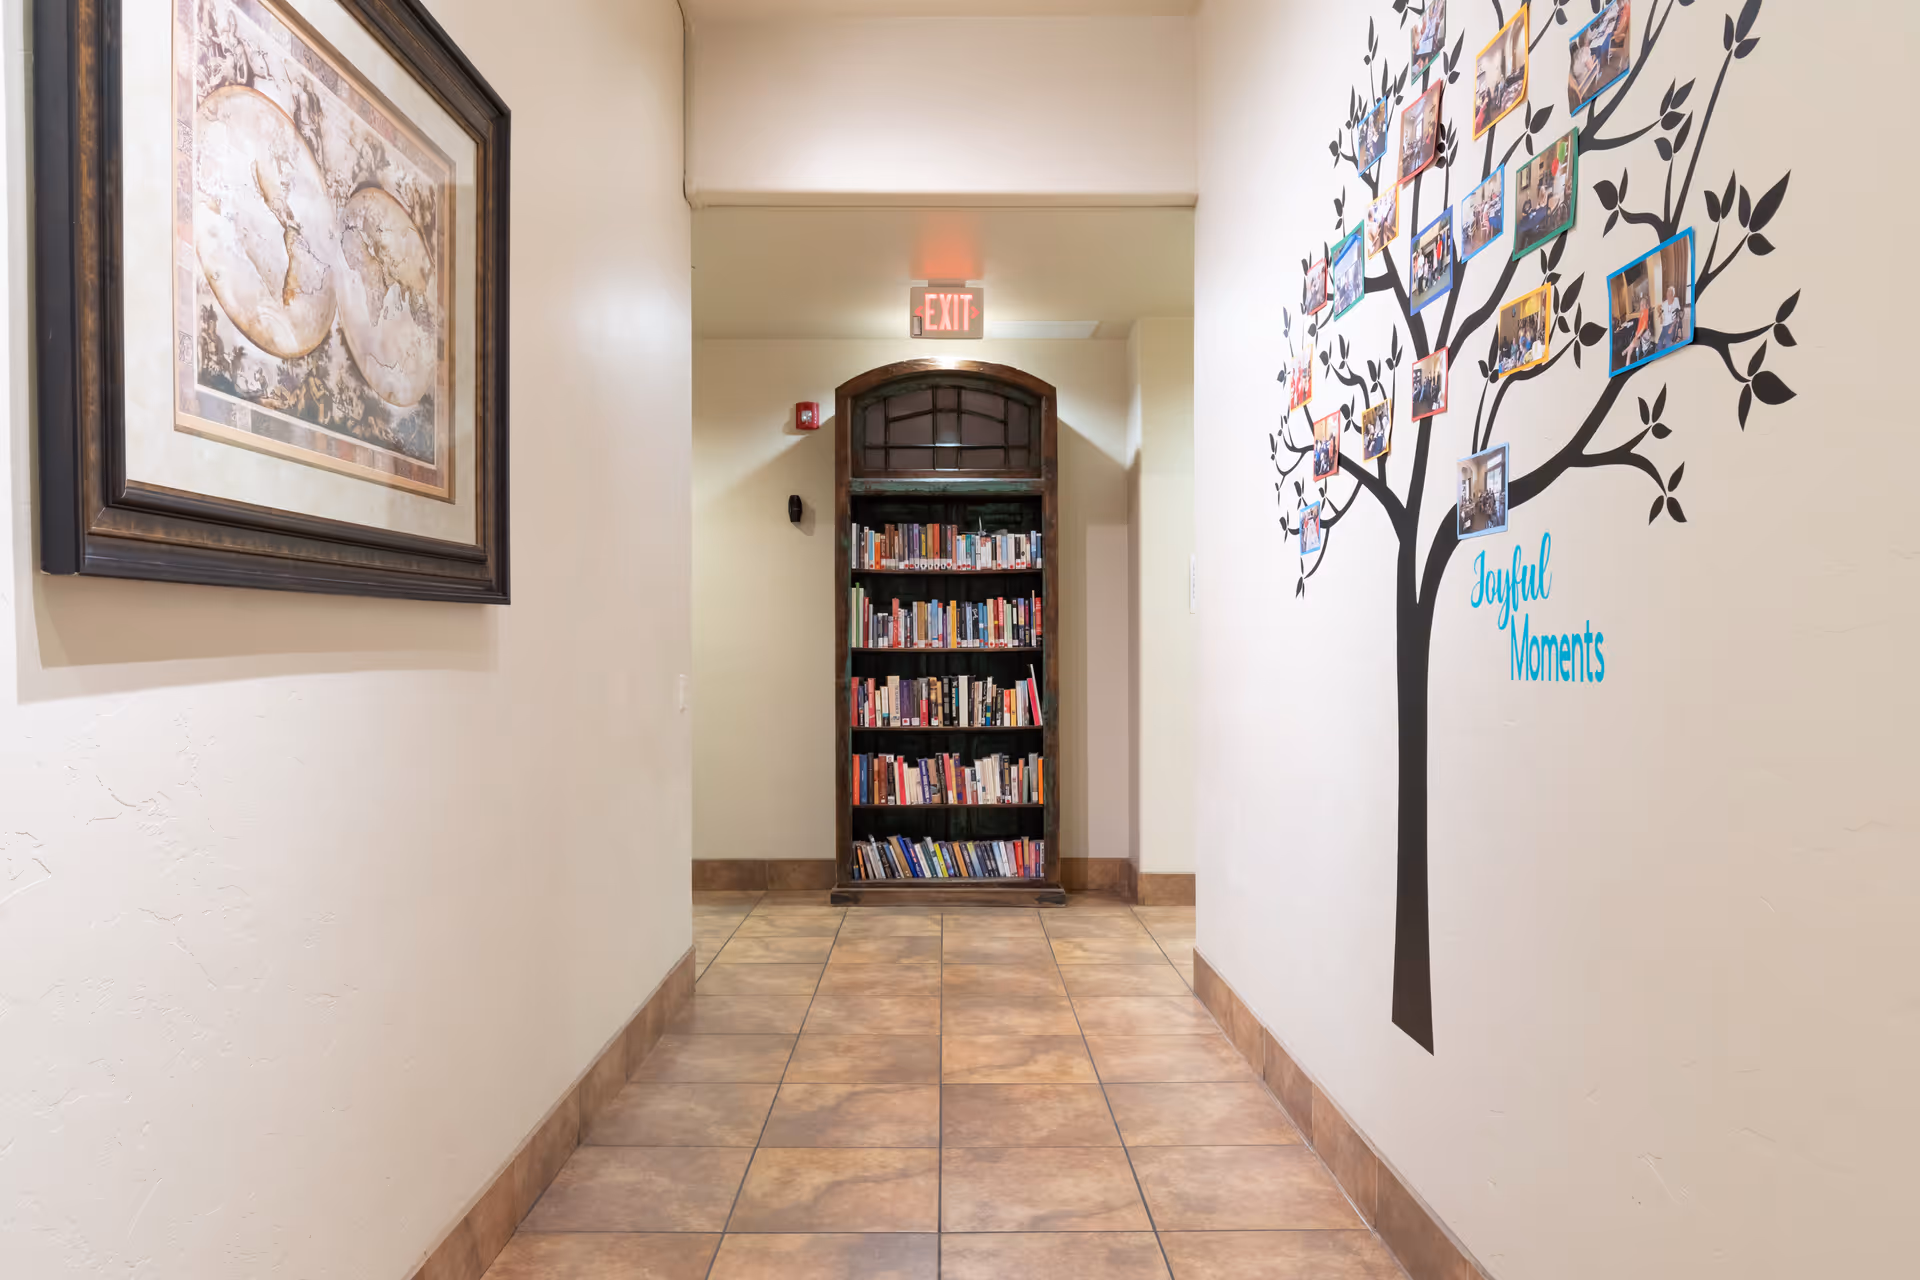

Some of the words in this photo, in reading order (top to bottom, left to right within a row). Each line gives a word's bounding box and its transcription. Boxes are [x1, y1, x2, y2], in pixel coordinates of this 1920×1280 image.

[924, 293, 973, 331] EXIT
[1470, 532, 1552, 630] Joyful
[1510, 613, 1605, 683] Moments
